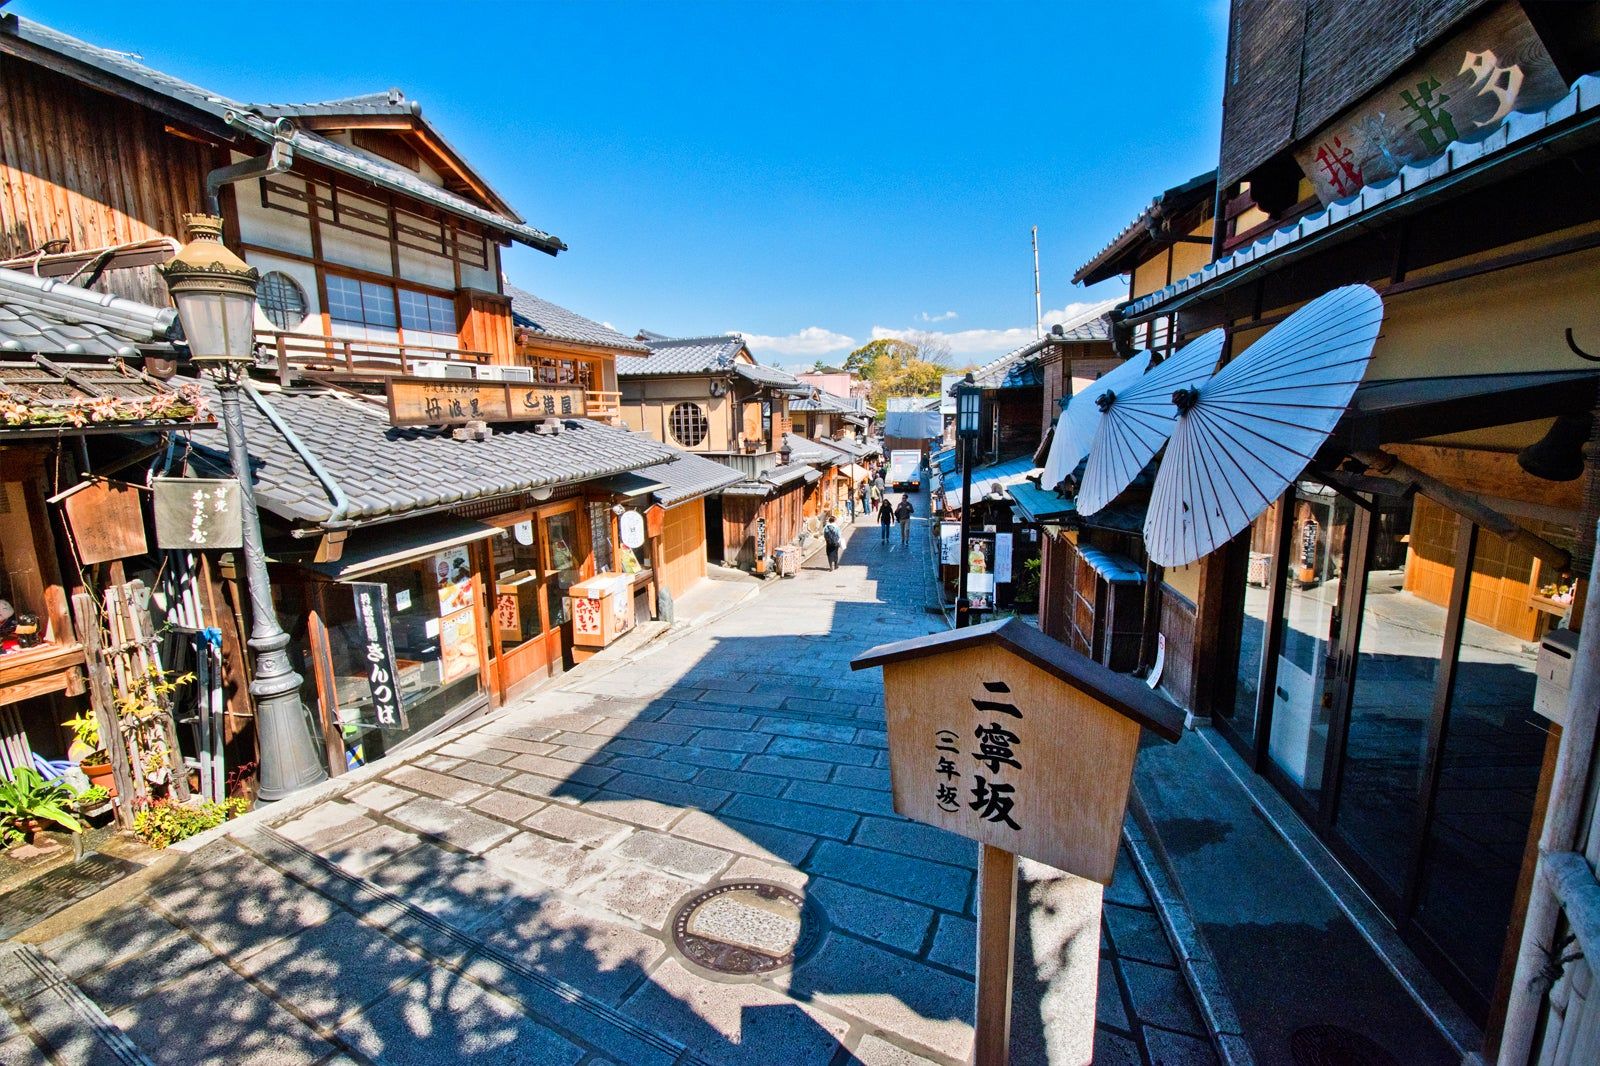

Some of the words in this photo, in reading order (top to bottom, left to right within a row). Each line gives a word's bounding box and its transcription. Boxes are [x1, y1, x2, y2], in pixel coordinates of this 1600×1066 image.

[425, 397, 485, 421] 丹波黒
[935, 729, 961, 813] (二年坂)
[968, 681, 1024, 832] 二寧坂
